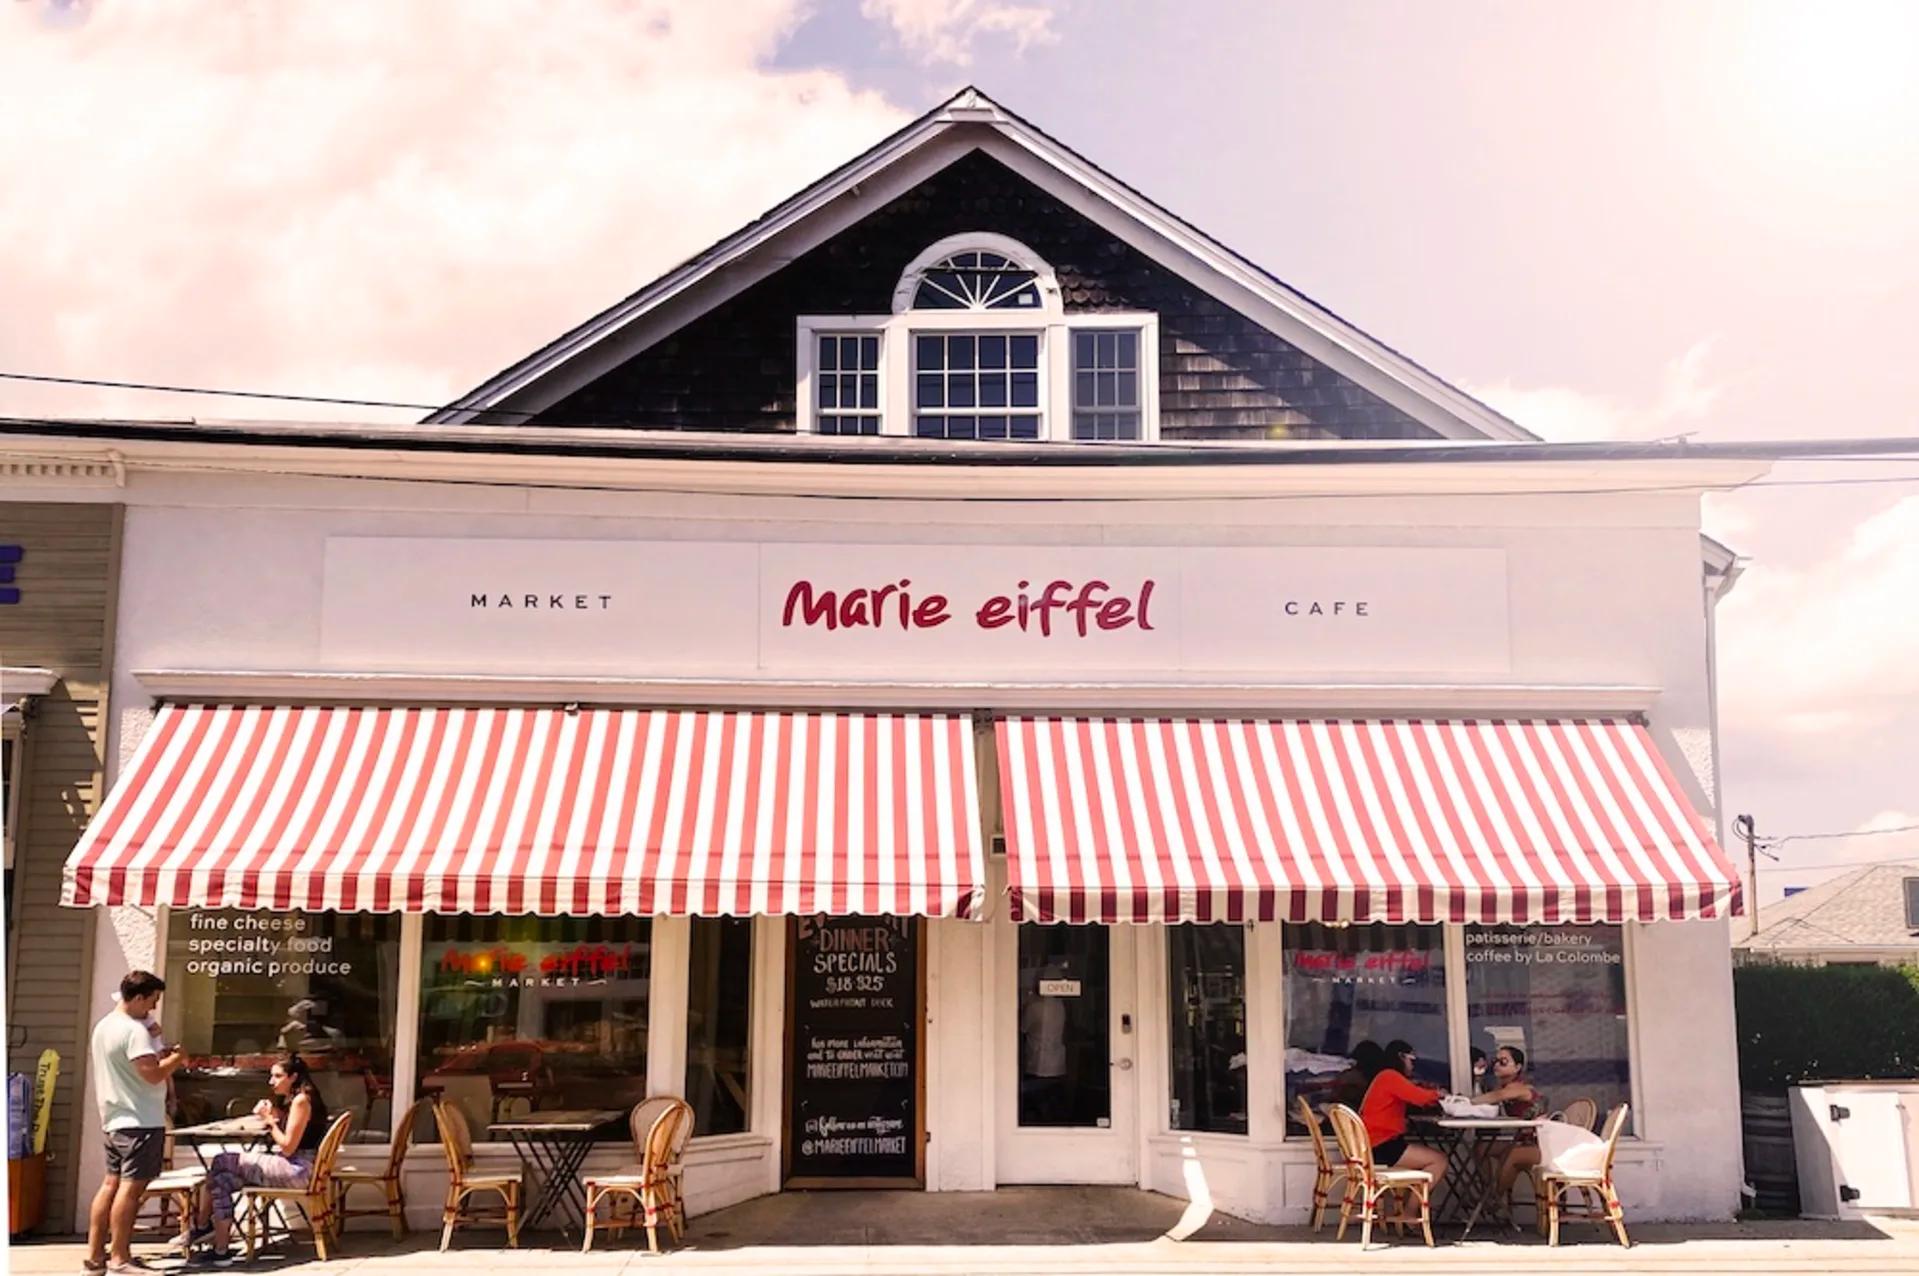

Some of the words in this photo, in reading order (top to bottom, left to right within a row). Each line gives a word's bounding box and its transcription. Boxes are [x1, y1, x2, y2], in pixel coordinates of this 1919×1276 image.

[471, 593, 612, 609] MARKET
[782, 579, 951, 631] Marie
[975, 579, 1154, 637] eiffel
[1284, 601, 1368, 616] CAFE
[190, 913, 228, 930] fine
[233, 914, 306, 931] cheese
[188, 936, 281, 955] specialty
[287, 936, 333, 952] food
[820, 927, 889, 952] DINNER
[1465, 932, 1592, 946] patisserie/bakery
[813, 952, 897, 974] SPECIALS
[1466, 950, 1512, 963] coffee
[1515, 951, 1532, 966] by
[1536, 951, 1553, 963] La
[1556, 950, 1620, 964] Colombe
[186, 957, 263, 977] organic
[267, 958, 352, 977] produce
[491, 977, 580, 988] MARKET
[1047, 983, 1074, 993] OPEN
[1331, 976, 1396, 985] MARKET
